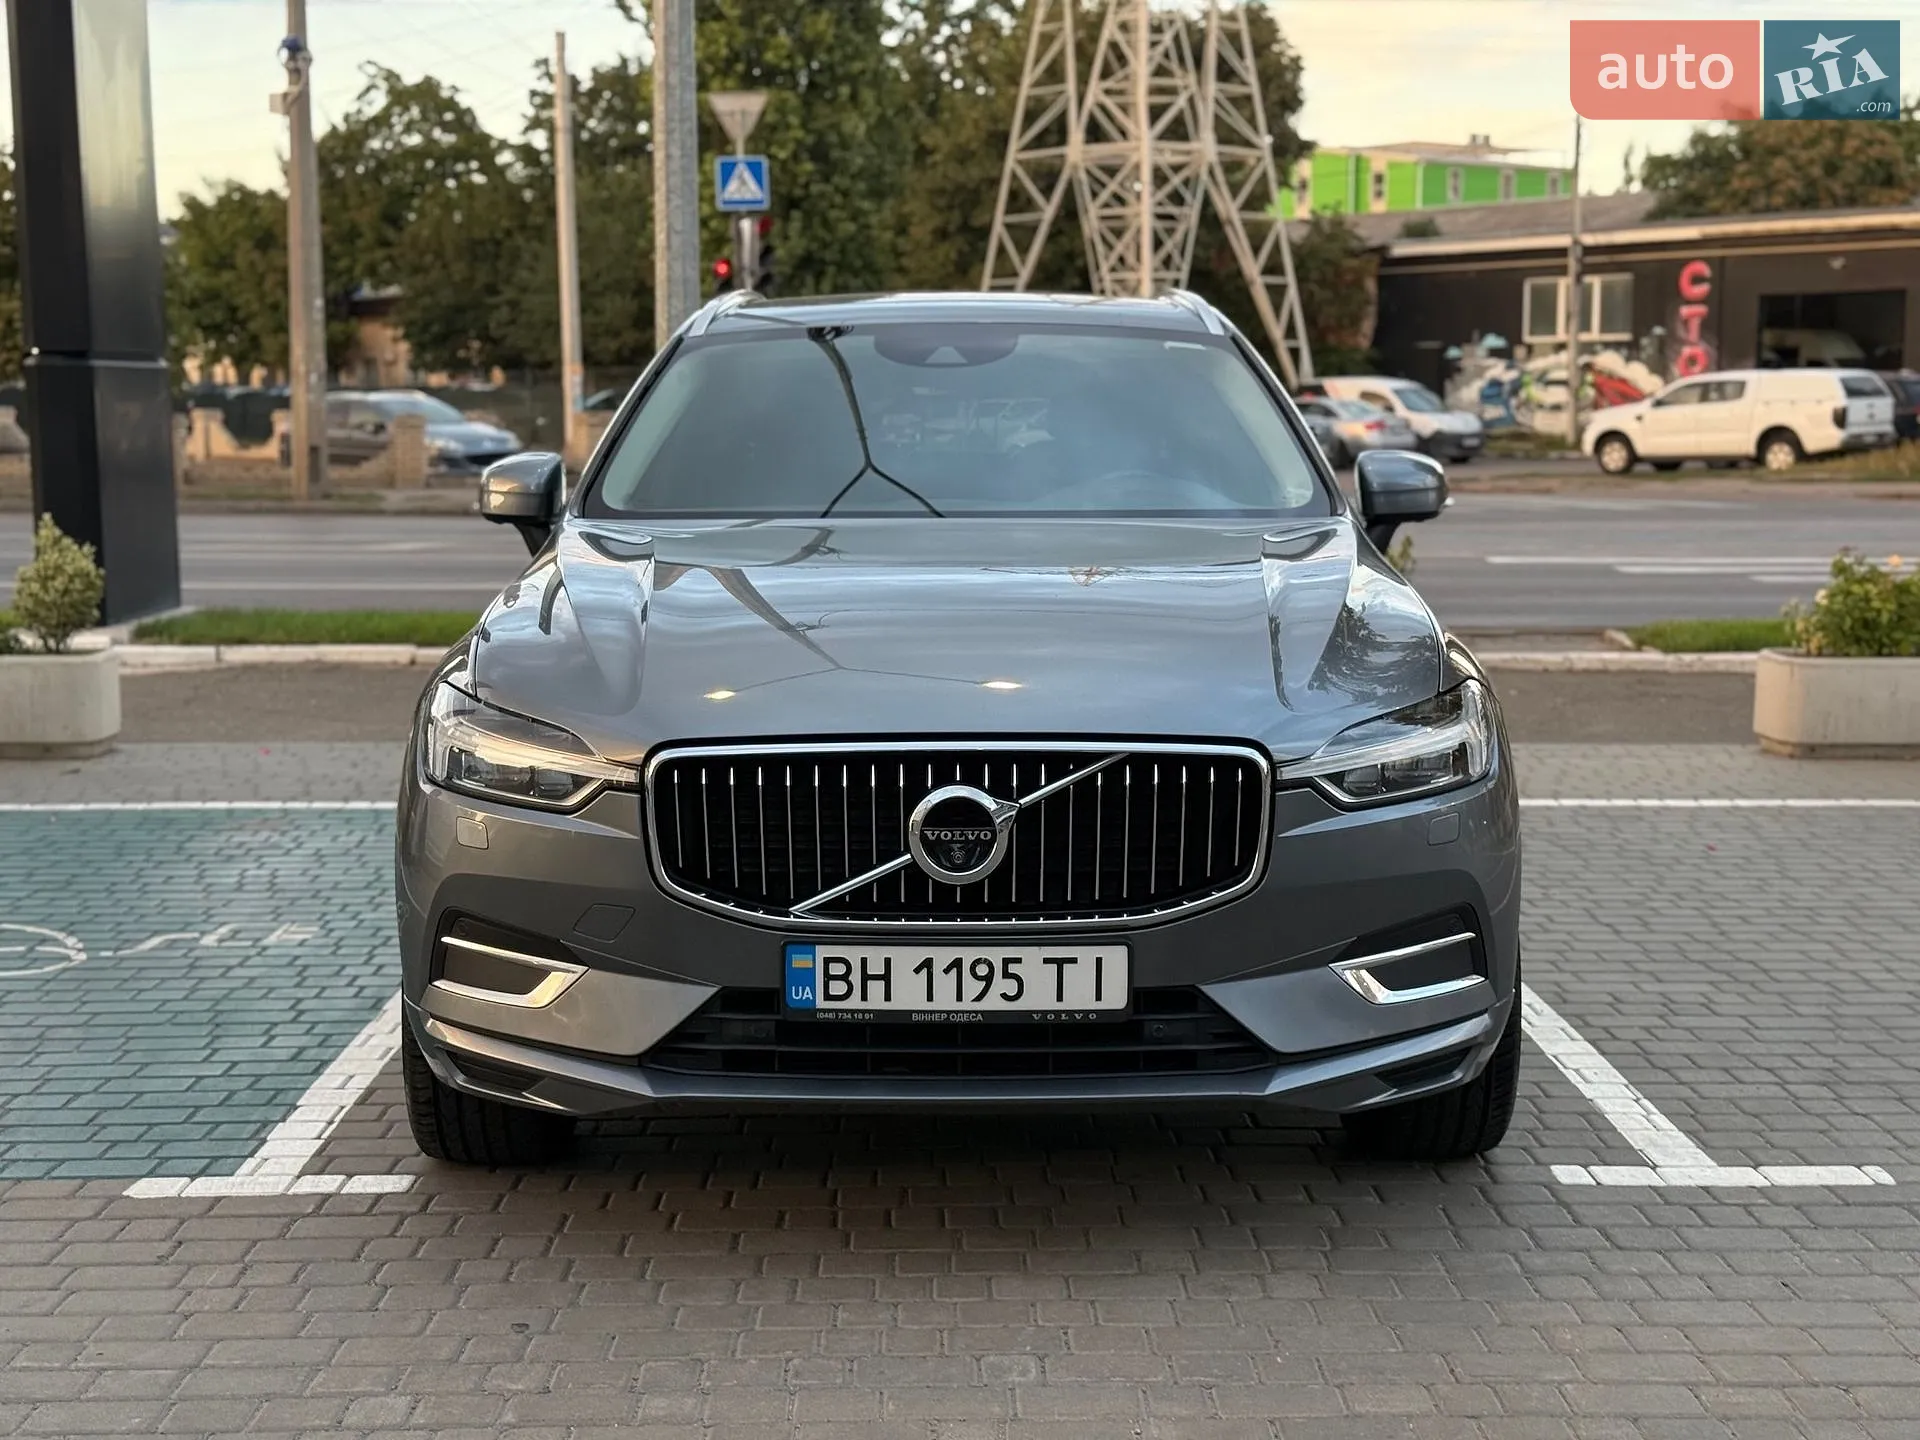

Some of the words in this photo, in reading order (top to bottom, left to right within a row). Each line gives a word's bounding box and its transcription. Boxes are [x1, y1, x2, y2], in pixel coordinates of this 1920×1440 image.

[923, 830, 992, 841] VOLVO
[822, 956, 892, 1002] BH
[912, 956, 1025, 1002] 1195
[792, 985, 813, 1000] UA
[911, 1012, 948, 1021] ВІННЕР
[950, 1012, 983, 1022] ОДЕСА
[1031, 1012, 1097, 1020] VOLVO
